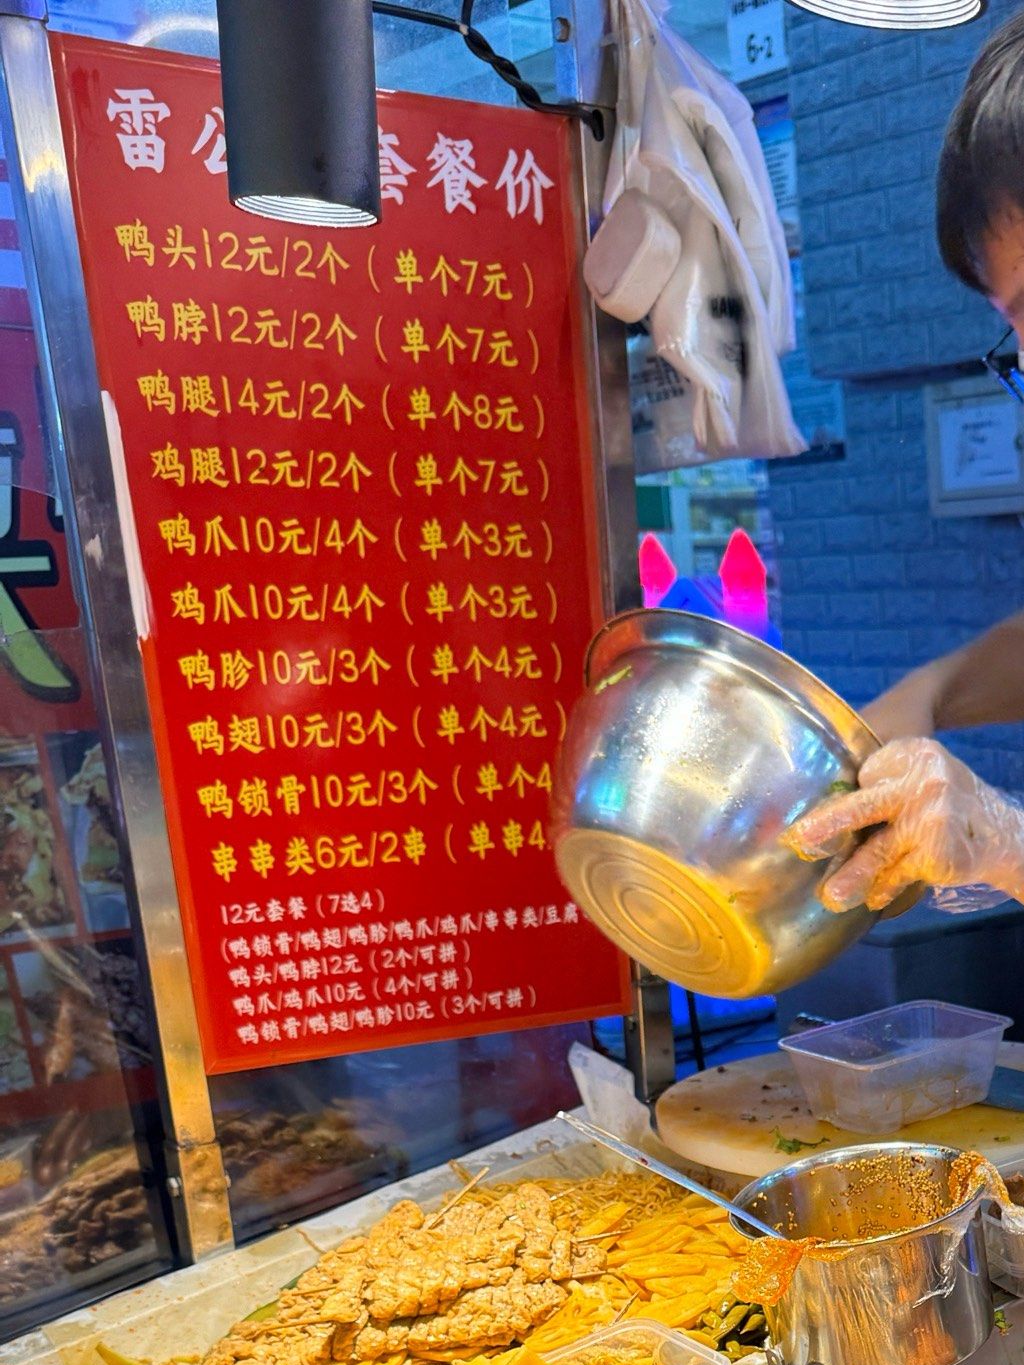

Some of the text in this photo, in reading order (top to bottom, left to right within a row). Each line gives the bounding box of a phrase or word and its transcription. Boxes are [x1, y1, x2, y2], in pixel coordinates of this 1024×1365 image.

[106, 87, 555, 226] 雷公套餐价
[196, 762, 553, 819] 鸭锁骨10元/3个（单个4
[209, 820, 551, 882] 串串类6元/2串（单串4
[219, 901, 590, 963] (鸭锁骨/鸭翅/鸭胗/鸭爪/鸡爪/串串类/豆腐
